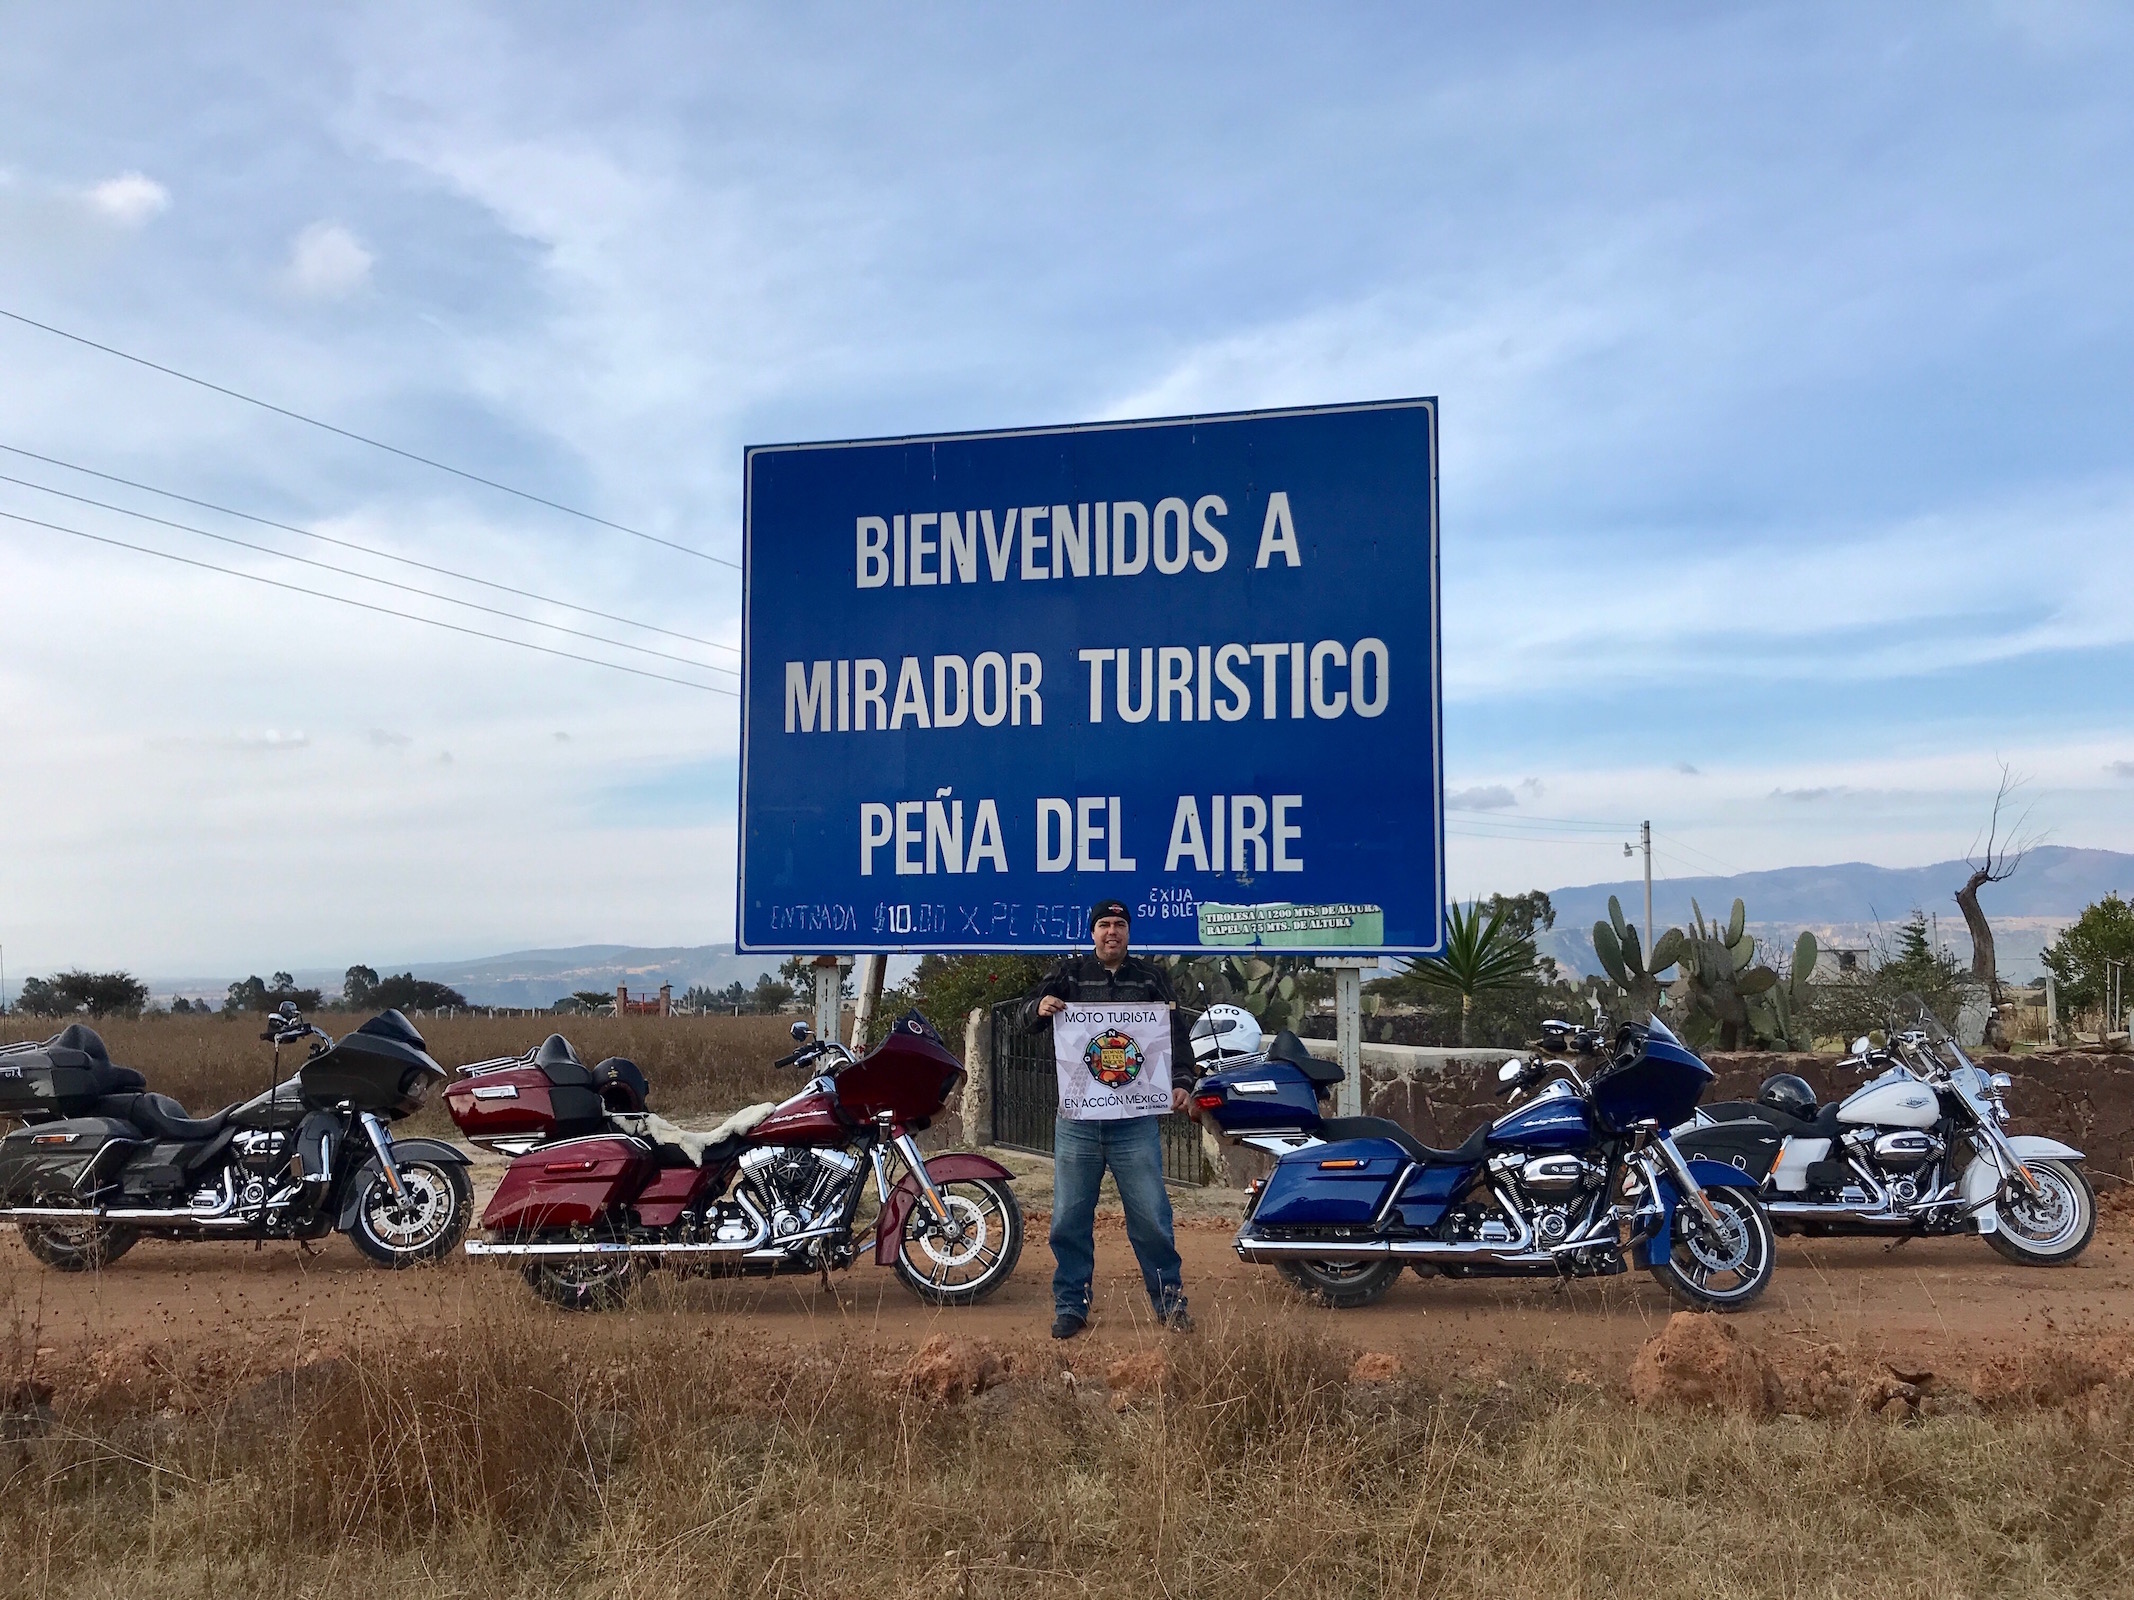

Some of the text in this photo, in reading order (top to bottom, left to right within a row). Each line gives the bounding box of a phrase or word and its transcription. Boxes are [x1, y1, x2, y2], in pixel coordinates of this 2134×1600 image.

[856, 491, 1302, 589] BIENVENIDOS A
[784, 637, 1389, 733] MIRADOR TURISTICO
[860, 786, 1304, 876] PEÑA DEL AIRE
[1149, 887, 1193, 902] EXIJA
[770, 903, 857, 931] ENTRADA
[1137, 903, 1156, 918] SU
[1205, 903, 1381, 923] TIROLESA A 1200 MTS. DE ALTURA
[1206, 917, 1352, 936] RAPEL A 75 MTS. DE ALTURA
[1064, 1011, 1157, 1024] MOTO TURISTA
[1064, 1098, 1081, 1109] EN
[1081, 1094, 1124, 1108] ACCIÓN
[1125, 1092, 1168, 1105] MÉXICO
